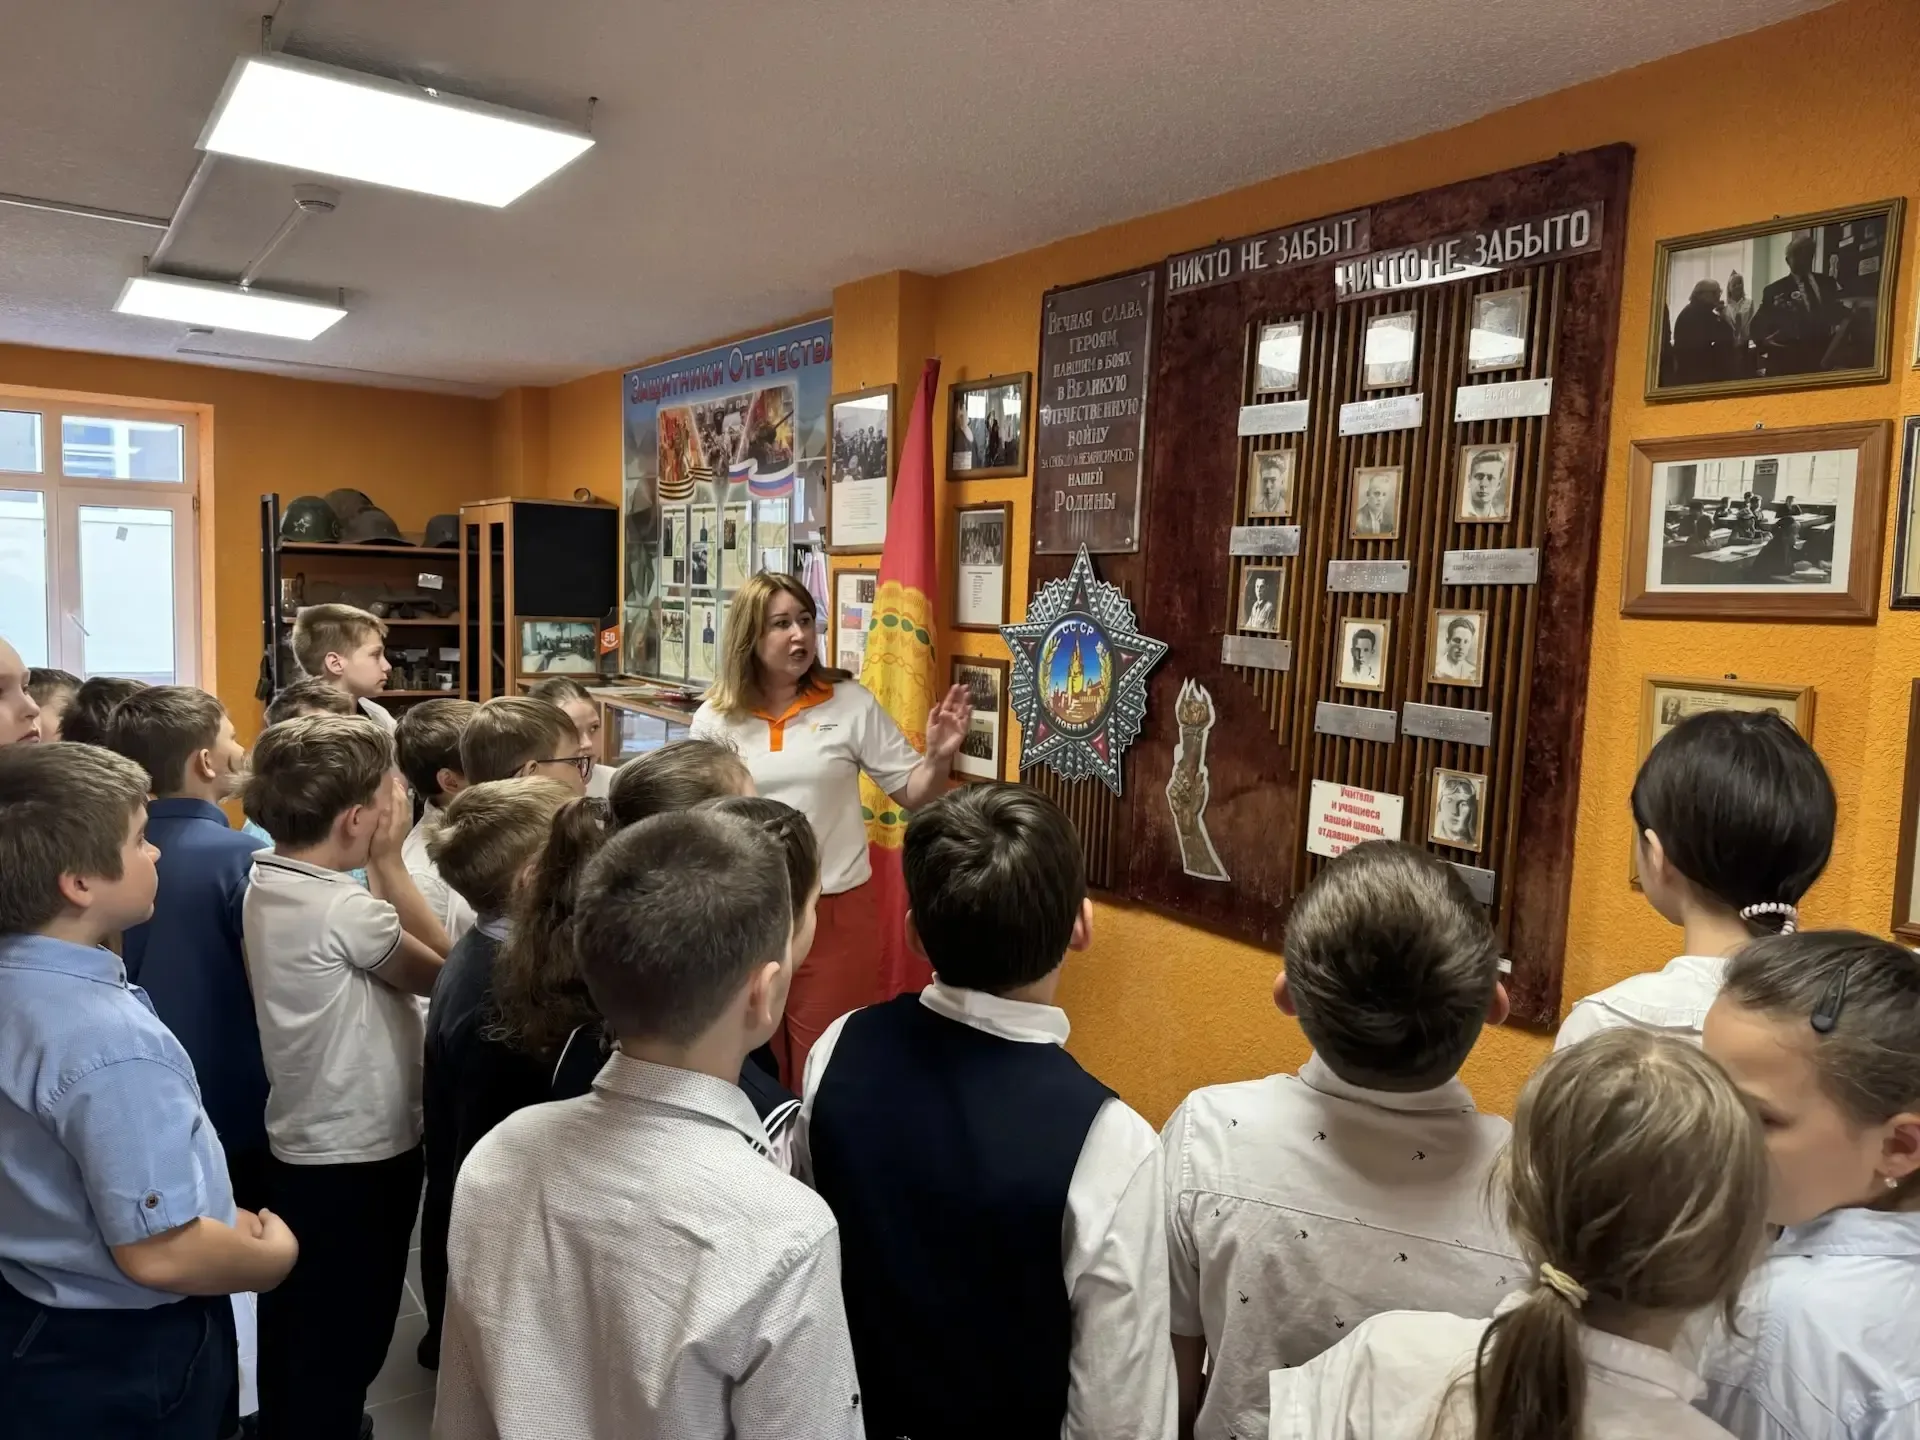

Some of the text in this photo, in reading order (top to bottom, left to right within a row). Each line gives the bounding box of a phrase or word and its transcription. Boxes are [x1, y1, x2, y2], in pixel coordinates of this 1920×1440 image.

[1169, 218, 1357, 290] НИКТО НЕ ЗАБЫТ
[1341, 209, 1591, 295] НИЧТО НЕ ЗАБЫТО
[1053, 357, 1097, 378] ПАВШИМ
[1104, 351, 1132, 369] БОЯХ
[1067, 423, 1109, 447] ВОЙНУ
[1068, 466, 1103, 487] НАШЕЙ
[1062, 621, 1094, 636] СССР
[1340, 786, 1375, 804] Учителя
[1331, 800, 1381, 820] и учащиеся
[1323, 813, 1352, 828] нашей
[1317, 827, 1360, 844] отдавшие
[1330, 844, 1340, 854] за
